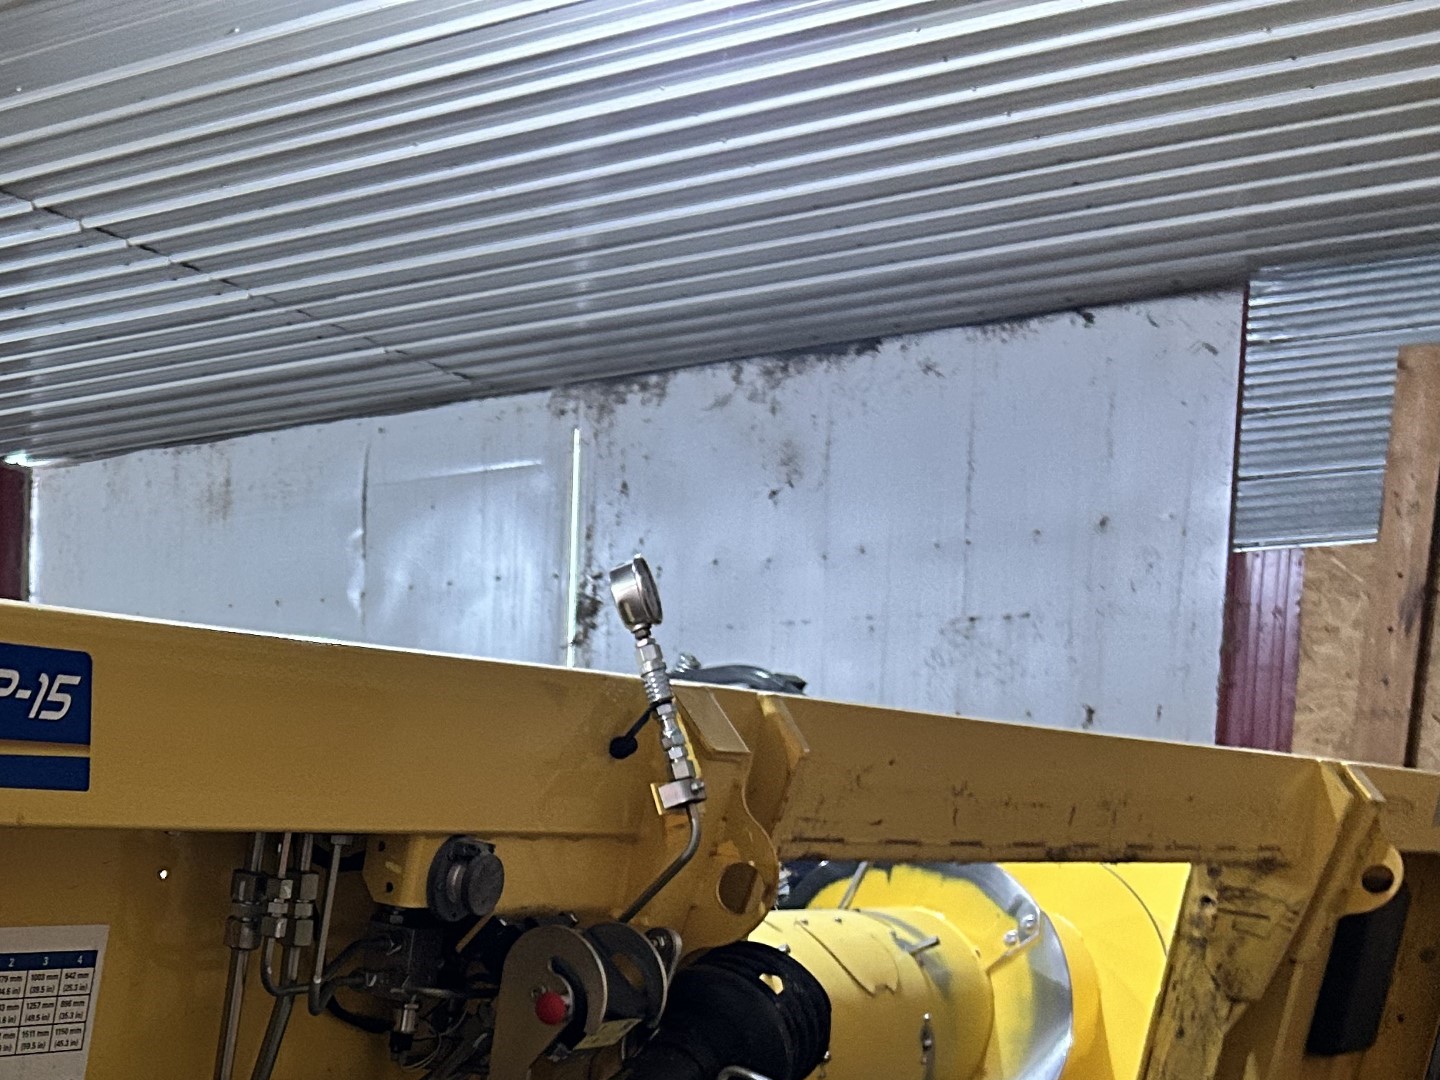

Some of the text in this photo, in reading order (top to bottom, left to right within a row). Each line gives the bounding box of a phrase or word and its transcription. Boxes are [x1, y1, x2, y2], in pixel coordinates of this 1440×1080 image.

[8, 958, 14, 967] 2
[43, 957, 49, 965] 3
[77, 955, 83, 964] 4
[12, 987, 20, 995] in)
[8, 1015, 16, 1023] in)
[3, 1044, 12, 1052] in)
